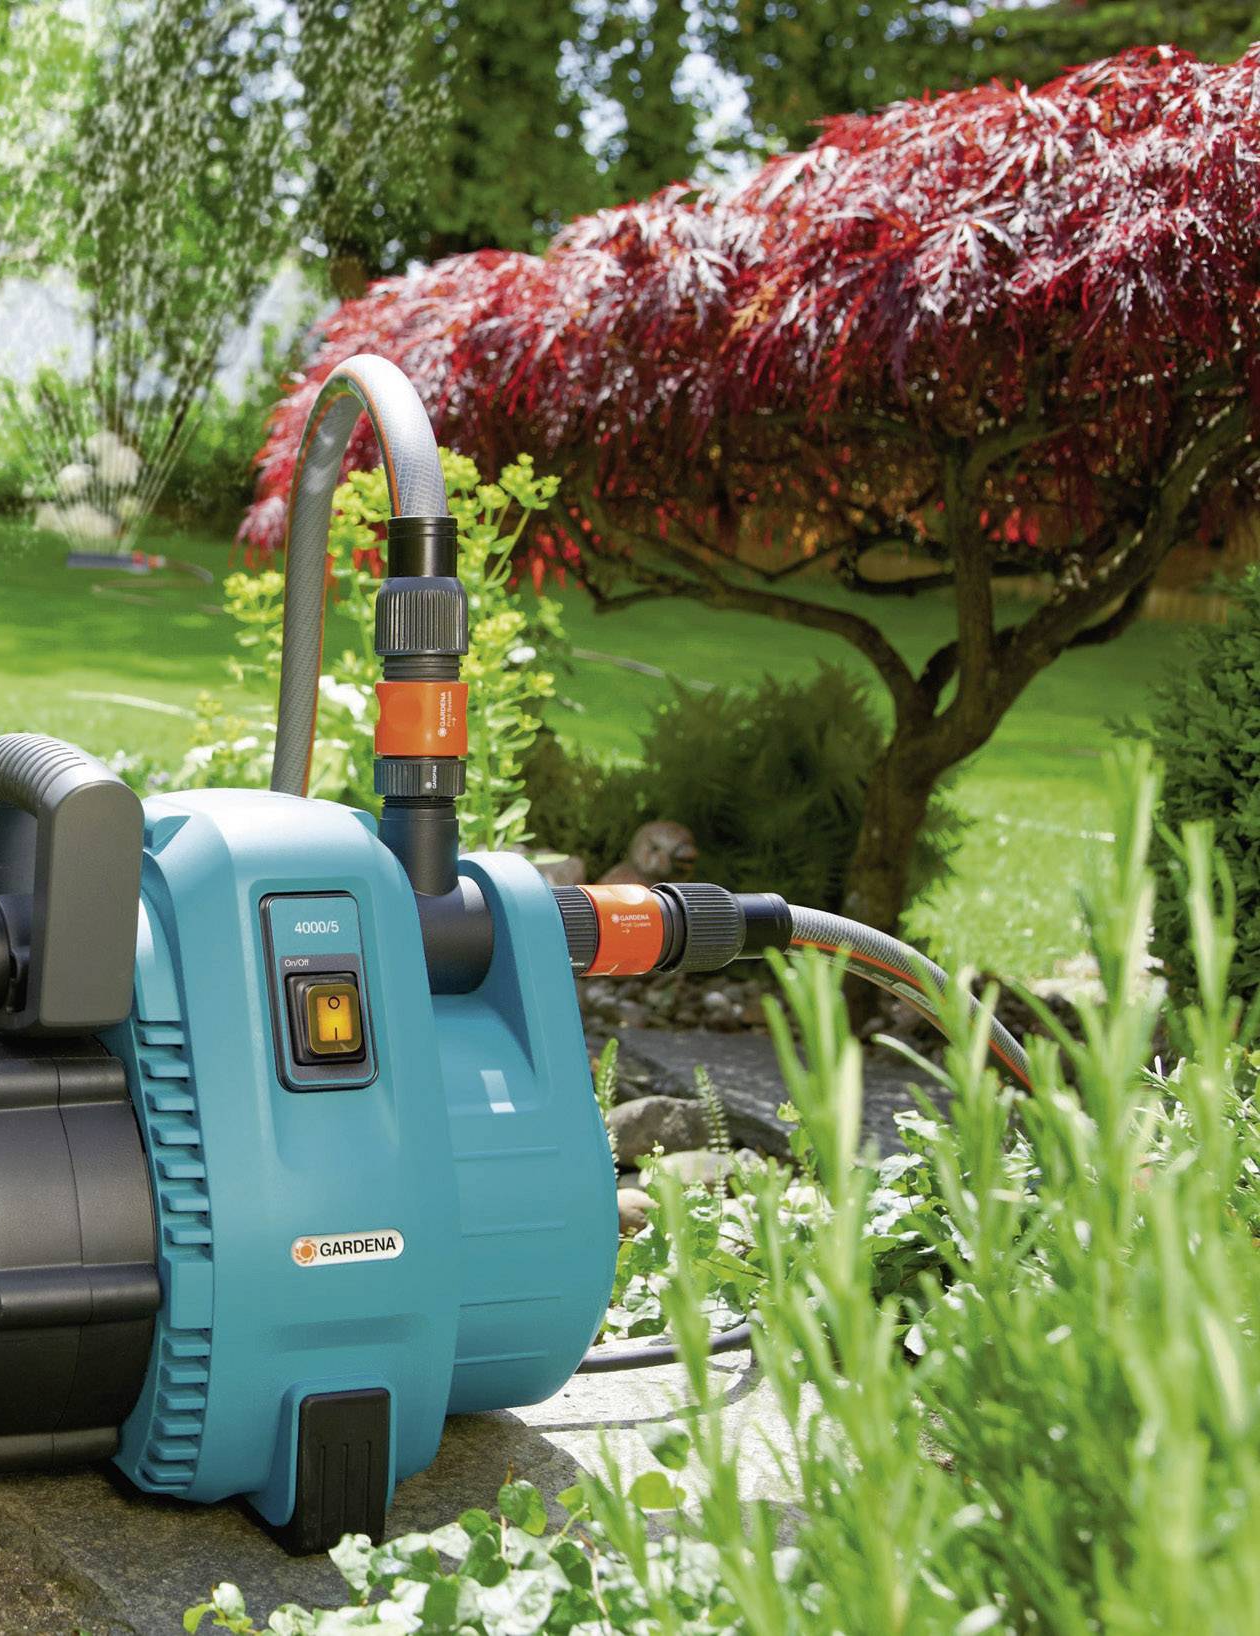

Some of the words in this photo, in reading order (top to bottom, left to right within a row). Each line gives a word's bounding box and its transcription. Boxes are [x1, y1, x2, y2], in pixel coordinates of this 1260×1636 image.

[294, 920, 340, 934] 4000/5
[284, 958, 309, 967] On/Off
[320, 1236, 396, 1257] GARDENA
